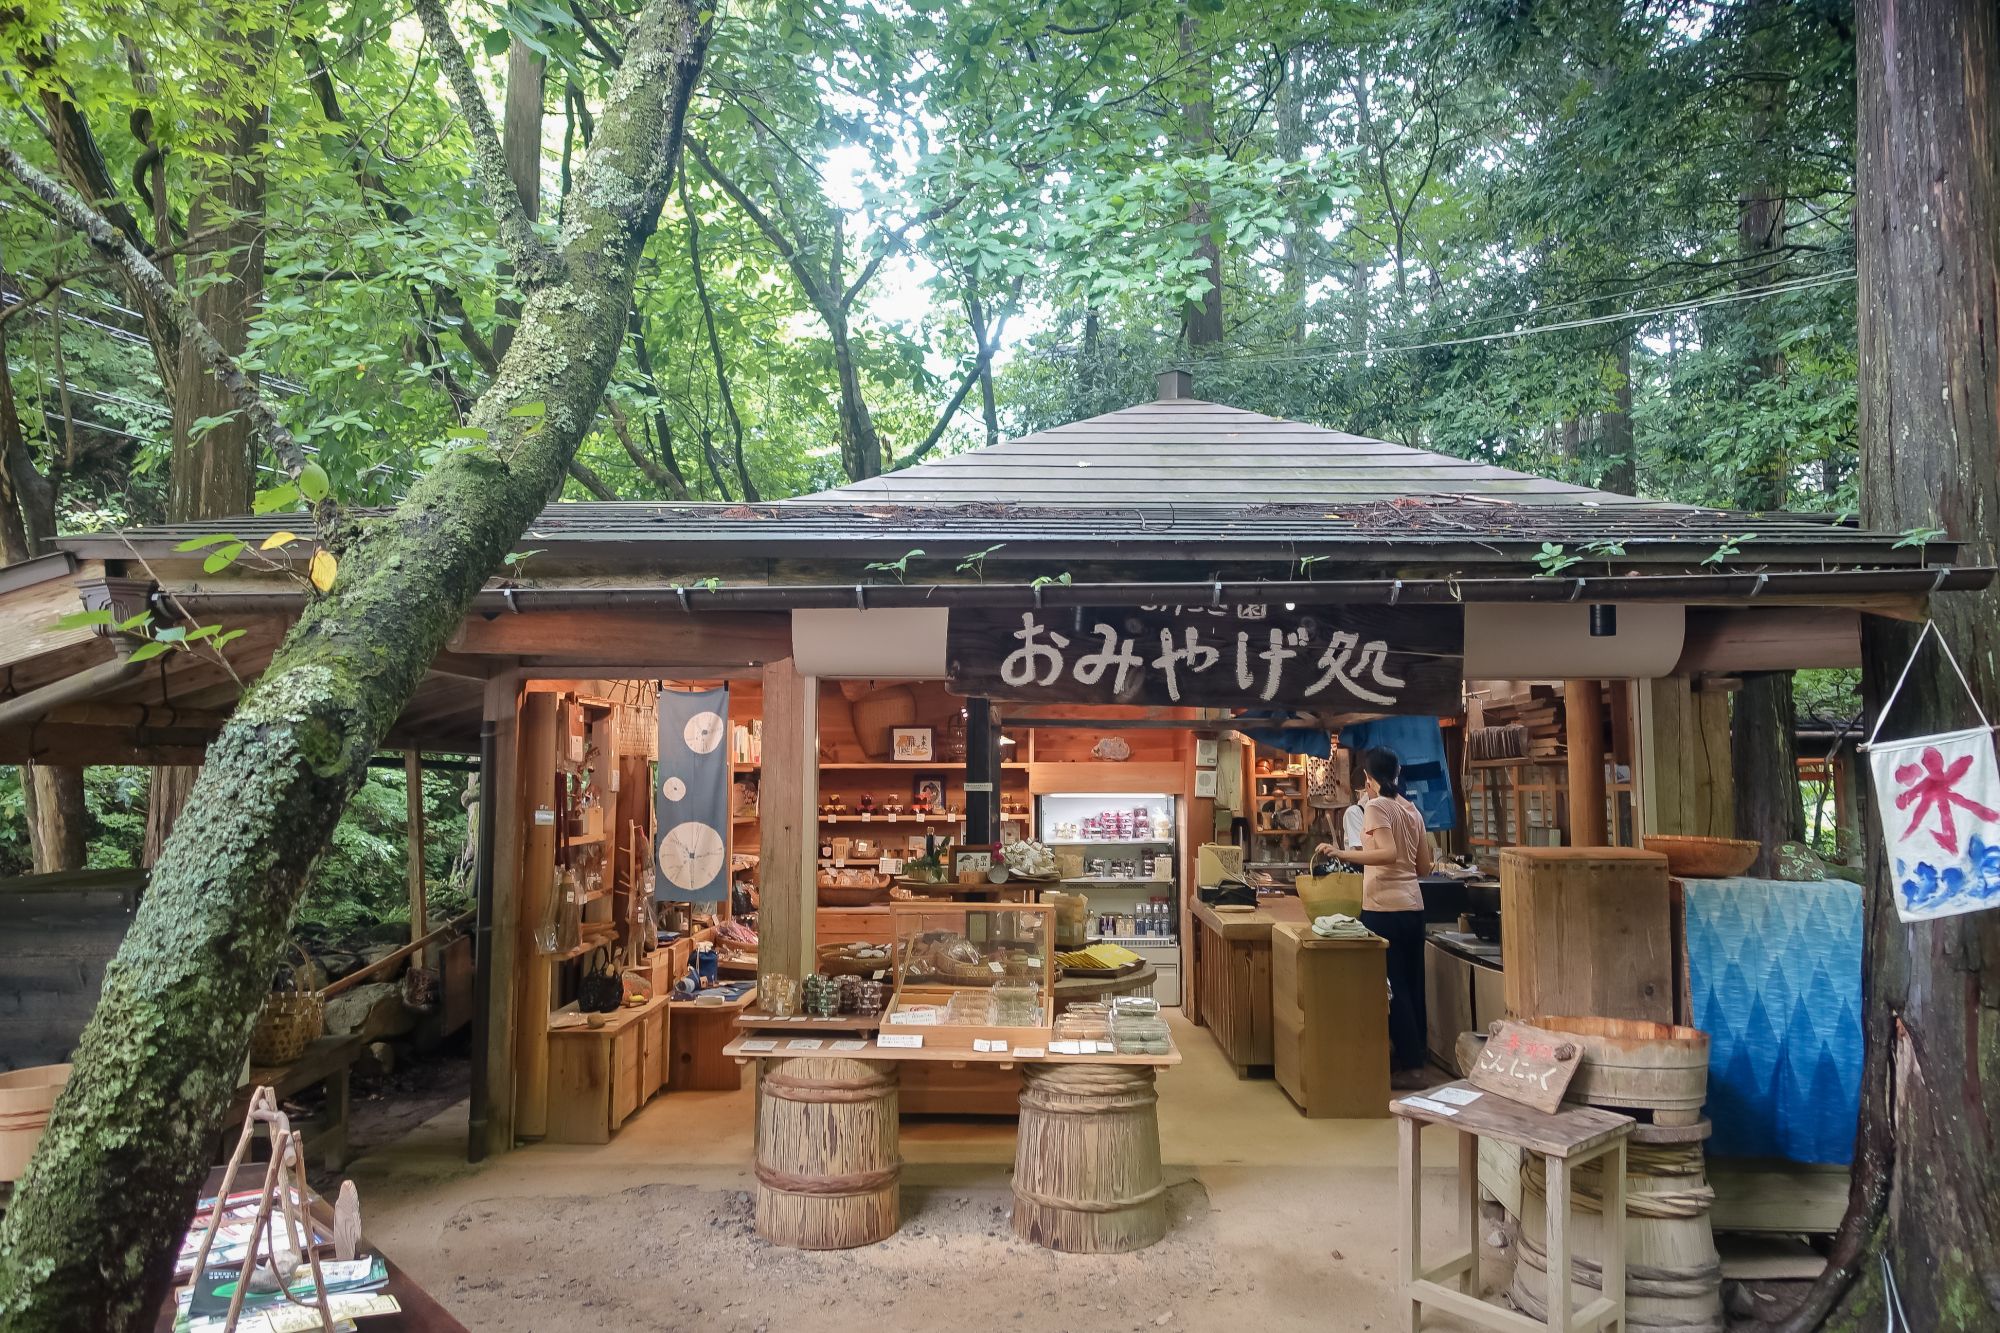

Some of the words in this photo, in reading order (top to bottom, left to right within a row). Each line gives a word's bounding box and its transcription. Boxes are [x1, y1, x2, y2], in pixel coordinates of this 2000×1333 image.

[1001, 612, 1405, 705] おみやげ処
[1895, 747, 2000, 856] 氷
[1480, 1048, 1557, 1091] こんにゃく
